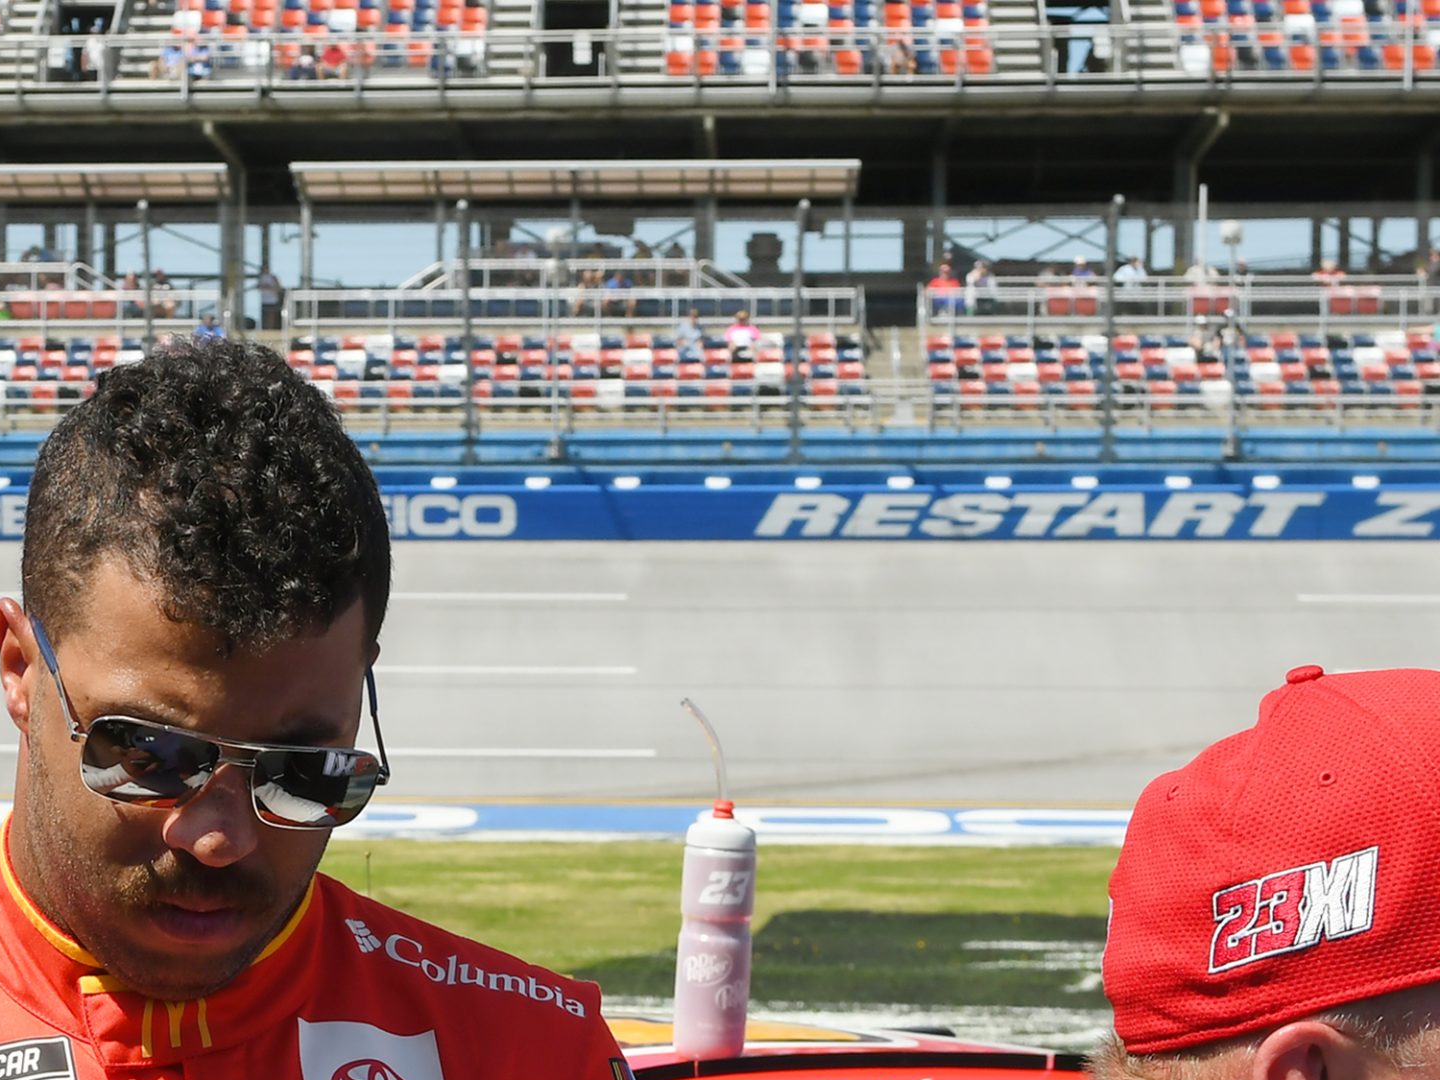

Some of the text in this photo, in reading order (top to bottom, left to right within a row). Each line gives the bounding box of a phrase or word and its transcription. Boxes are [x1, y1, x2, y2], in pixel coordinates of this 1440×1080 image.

[391, 494, 517, 538] ICO
[756, 492, 1326, 537] RESTART
[698, 870, 753, 905] 23
[1209, 846, 1378, 973] 23XI
[385, 933, 586, 1018] Columbia
